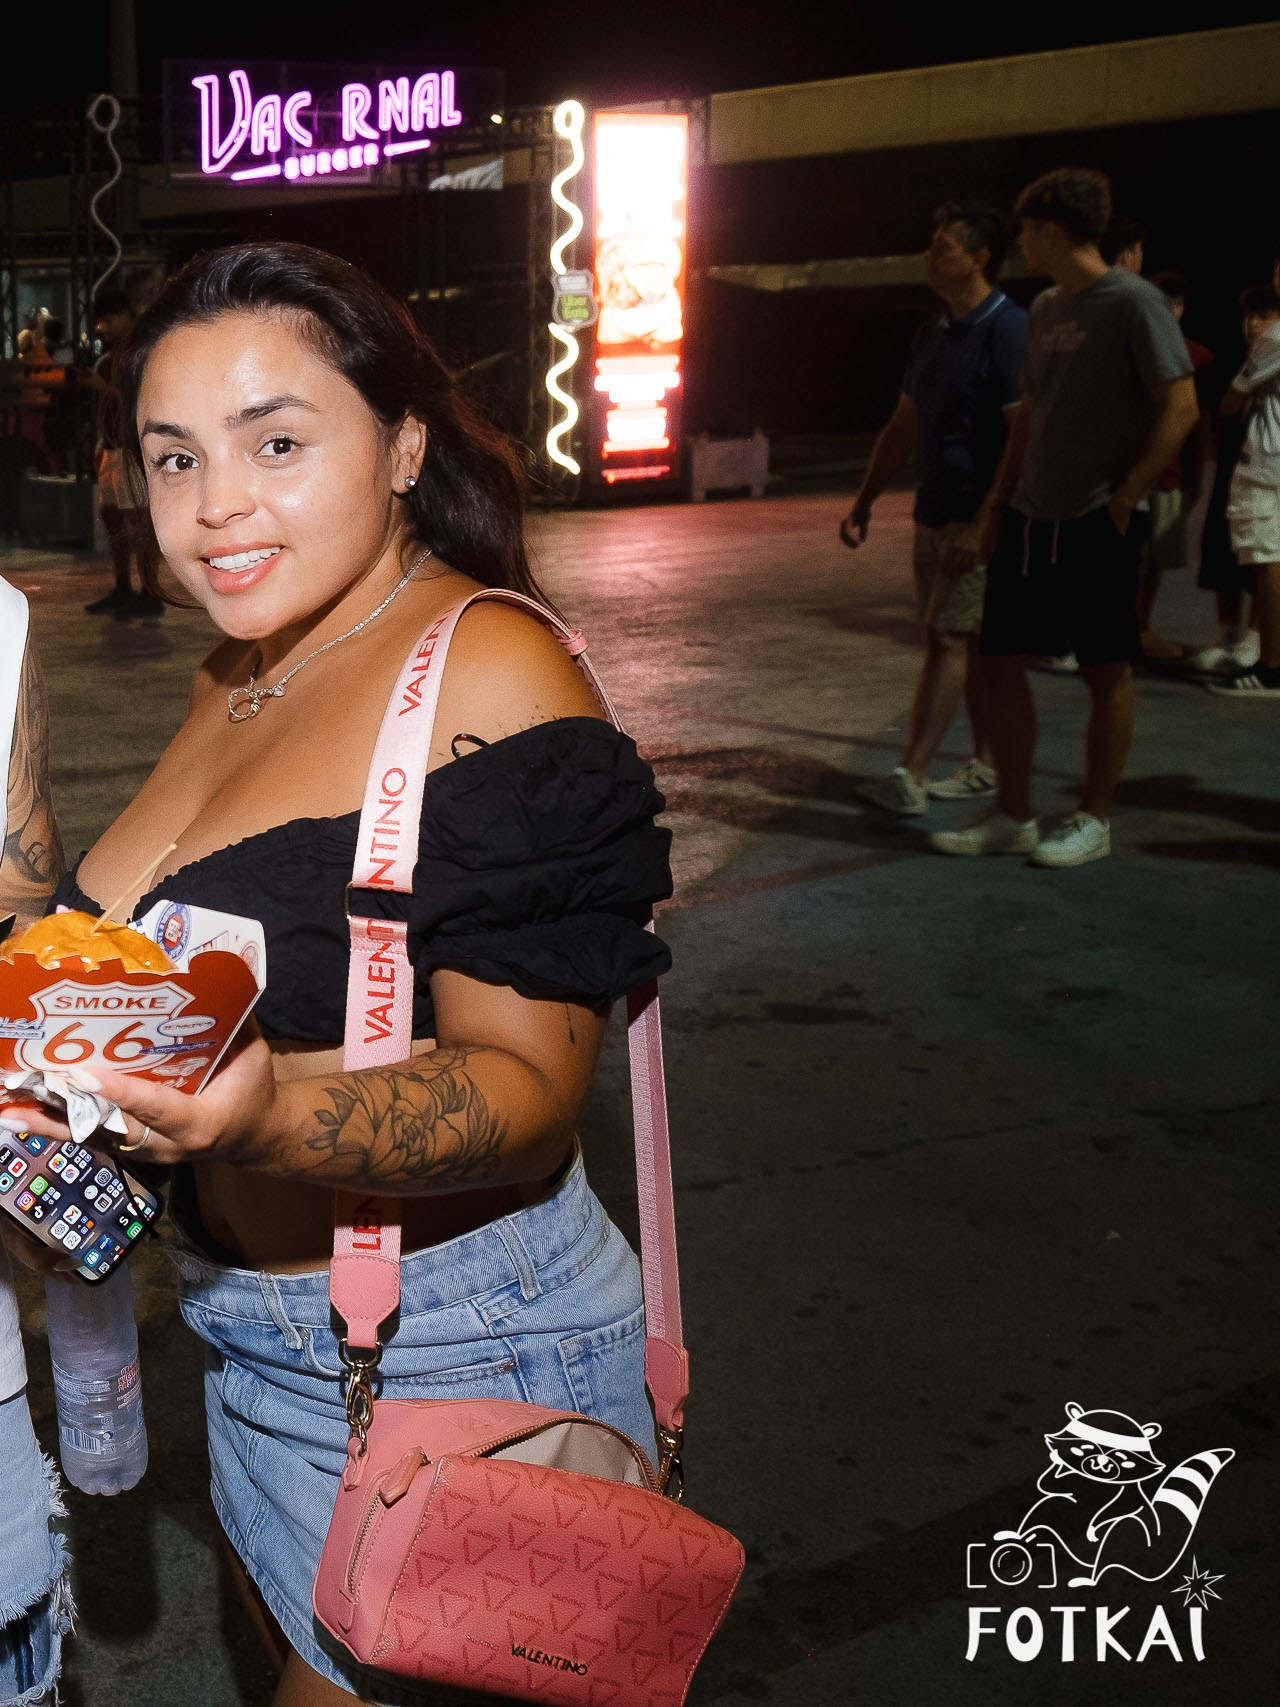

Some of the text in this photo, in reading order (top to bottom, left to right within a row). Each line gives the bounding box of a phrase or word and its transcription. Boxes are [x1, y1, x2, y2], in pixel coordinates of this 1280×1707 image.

[54, 995, 170, 1011] SMOKE
[42, 1021, 156, 1065] 66
[511, 1643, 588, 1676] VALENTINO
